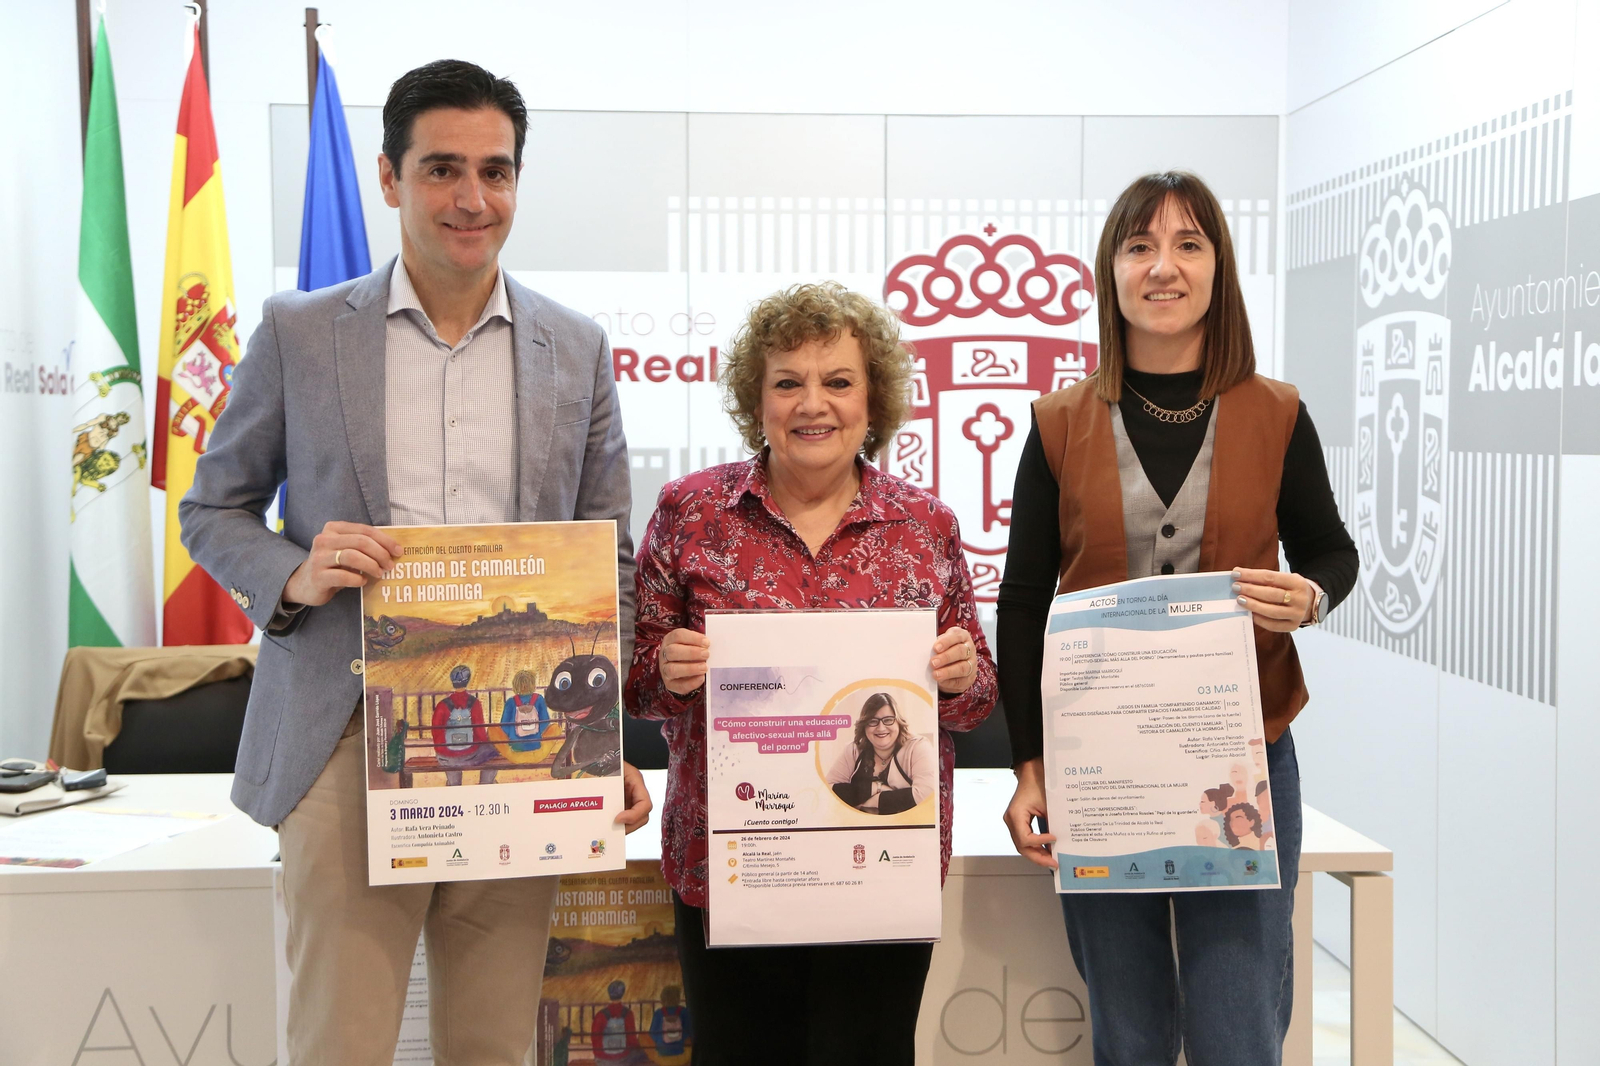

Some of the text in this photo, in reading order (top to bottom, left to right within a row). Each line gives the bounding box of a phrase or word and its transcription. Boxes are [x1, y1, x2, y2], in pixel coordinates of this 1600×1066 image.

[669, 306, 716, 336] de
[612, 346, 718, 383] Real
[1468, 330, 1600, 392] Alcalá la
[4, 361, 34, 394] Real
[38, 364, 68, 395] Sala
[403, 544, 503, 555] ENTACIÓN DEL CUENTO FAMILIAR
[450, 560, 467, 578] DE
[471, 555, 545, 576] CAMALEÓN
[381, 583, 483, 603] Y LA HORMIGA
[1089, 597, 1116, 608] ACTOS
[1157, 594, 1168, 602] DÍA
[1101, 609, 1147, 618] INTERNACIONAL
[1170, 604, 1203, 613] MUJER
[1061, 641, 1088, 650] 26 FEB
[720, 682, 786, 691] CONFERENCIA:
[1197, 684, 1238, 694] 03 MAR
[748, 718, 786, 727] construir
[806, 717, 848, 726] educación
[732, 731, 794, 739] afectivo-sexual
[1064, 766, 1102, 776] 08 MAR
[758, 789, 790, 801] Marina
[390, 808, 396, 820] 3
[400, 806, 435, 820] MARZO
[438, 804, 464, 818] 2024
[474, 803, 500, 816] 12.30
[504, 802, 510, 814] h
[539, 800, 598, 810] PALACIO ABACIAL
[771, 818, 798, 826] contigo!
[556, 891, 606, 906] HISTORIA
[610, 890, 624, 905] DE
[552, 910, 637, 927] Y LA HORMIGA
[940, 965, 1086, 1055] de
